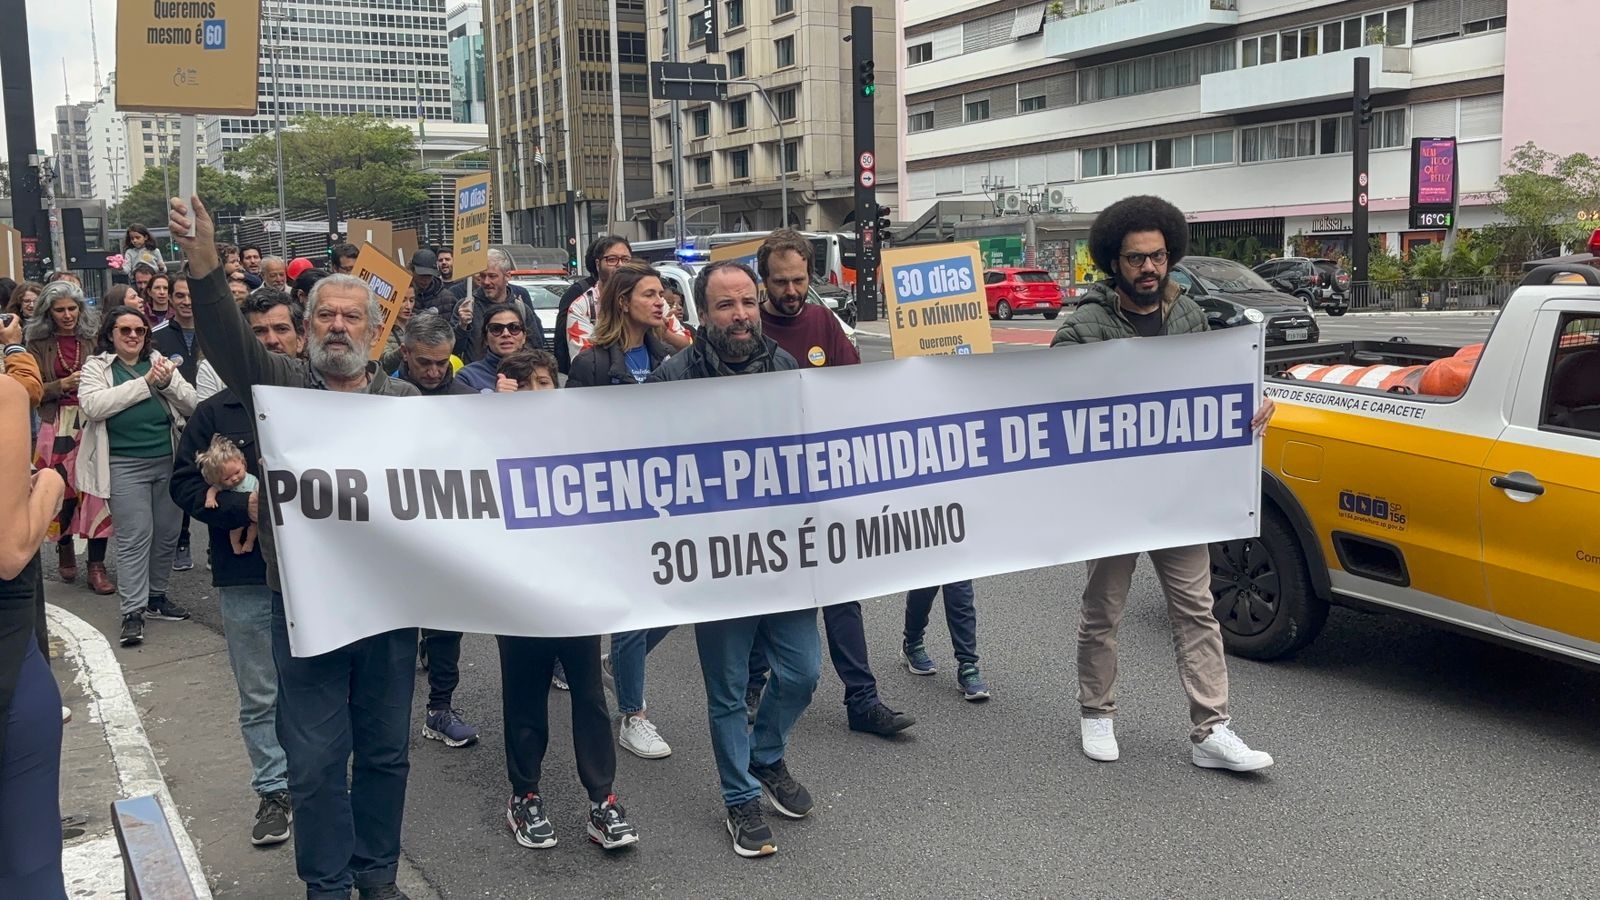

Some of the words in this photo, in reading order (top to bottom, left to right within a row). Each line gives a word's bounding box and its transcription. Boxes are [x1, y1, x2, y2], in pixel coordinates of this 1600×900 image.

[154, 0, 216, 19] Queremos
[147, 27, 192, 44] mesmo
[195, 23, 203, 44] é
[205, 25, 222, 46] 60
[862, 156, 872, 164] 50
[459, 191, 469, 210] 30
[470, 187, 486, 208] dias
[1312, 216, 1342, 231] melissa
[369, 275, 393, 299] APOIO
[391, 291, 398, 304] A
[897, 268, 924, 297] 30
[928, 264, 972, 294] dias
[895, 306, 905, 329] É
[908, 309, 918, 328] O
[922, 302, 983, 326] MÍNIMO!
[920, 335, 963, 350] Queremos
[1264, 387, 1288, 399] CINTO
[1289, 390, 1303, 401] DE
[1303, 392, 1360, 411] SEGURANÇA
[1361, 400, 1369, 411] E
[1370, 402, 1426, 420] CAPACETE!
[268, 468, 369, 526] POR
[385, 468, 500, 520] UMA
[509, 420, 989, 518] LICENÇA-PATERNIDADE
[1000, 412, 1050, 463] DE
[1062, 393, 1243, 454] VERDADE
[1390, 502, 1402, 512] SP
[1390, 512, 1406, 524] 156
[651, 539, 698, 585] 30
[708, 529, 788, 579] DIAS
[798, 517, 818, 568] É
[827, 522, 846, 564] O
[856, 505, 966, 559] MÍNIMO
